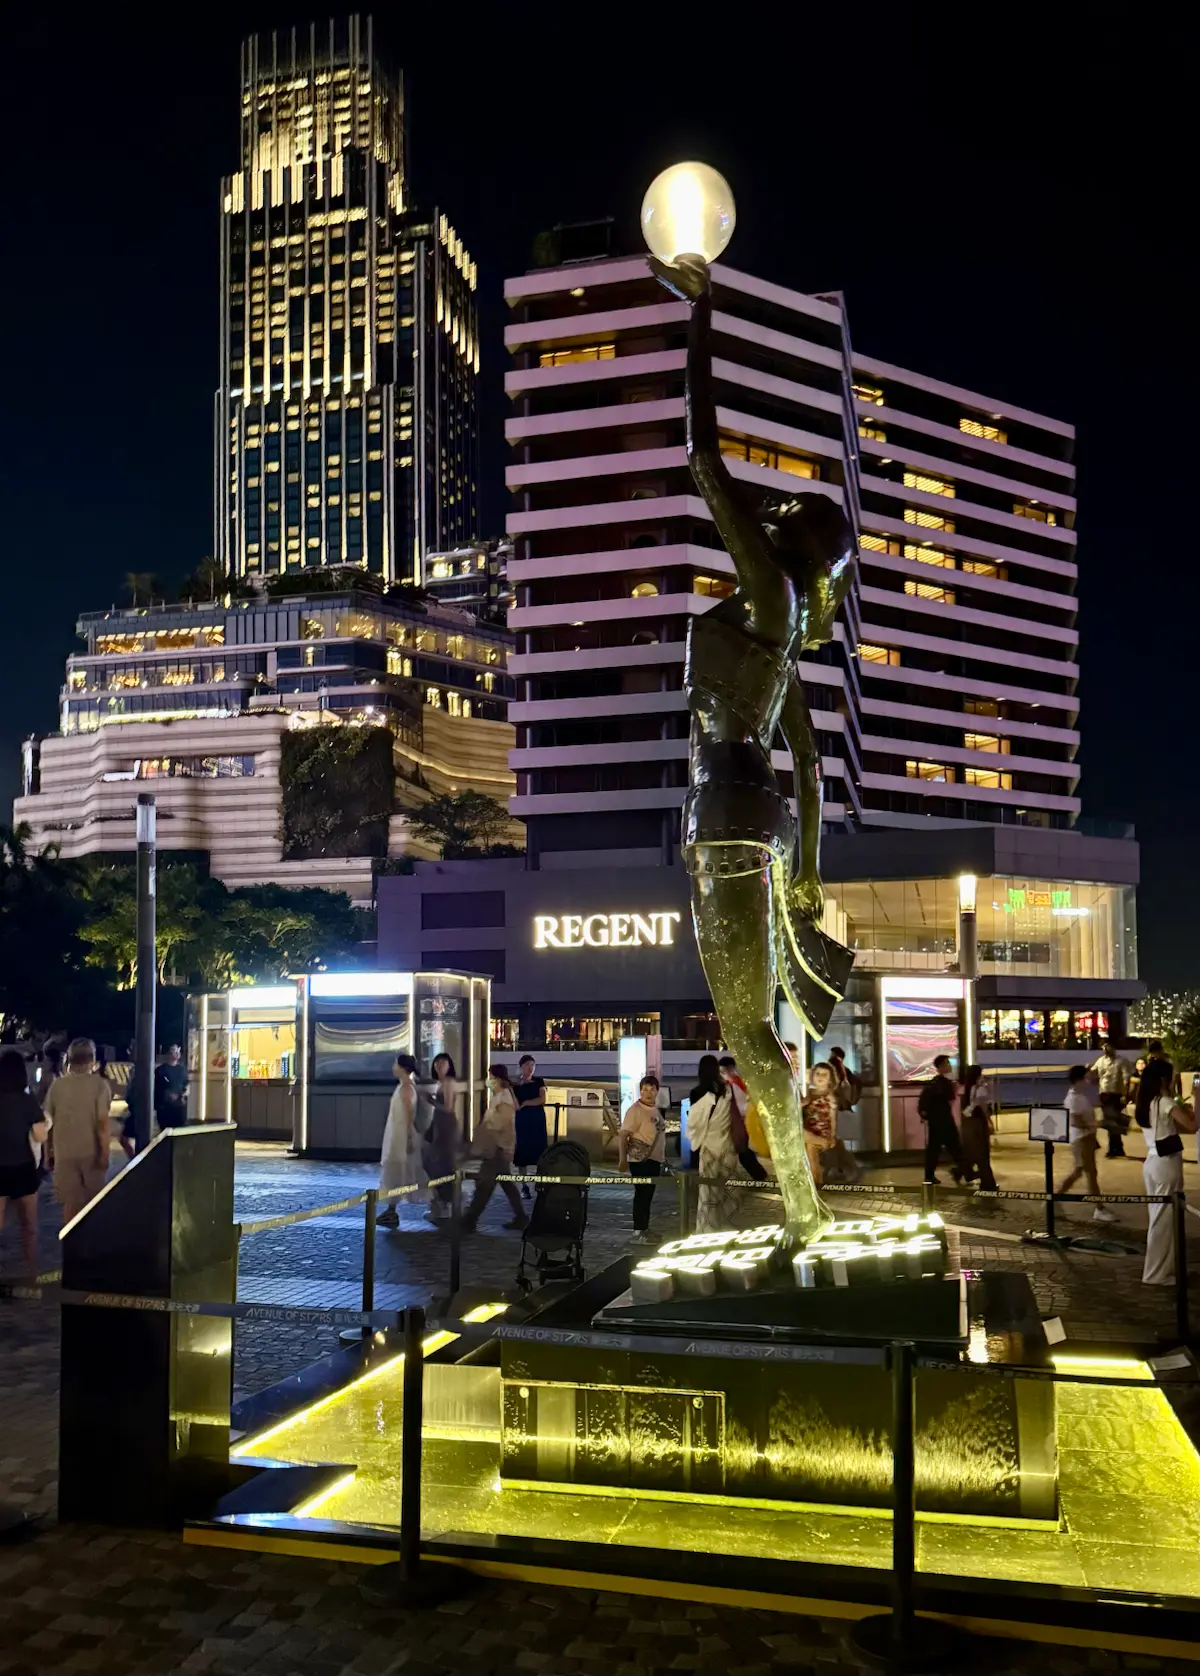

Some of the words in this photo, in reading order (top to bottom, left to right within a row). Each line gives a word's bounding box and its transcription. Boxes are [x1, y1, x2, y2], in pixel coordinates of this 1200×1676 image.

[534, 912, 680, 949] REGENT
[845, 1184, 852, 1192] OF
[973, 1190, 998, 1198] AVENUE
[84, 1293, 121, 1306] AVENUE
[122, 1296, 134, 1306] OF
[245, 1307, 285, 1320] AVENUE
[285, 1310, 297, 1321] OF
[492, 1328, 535, 1340] AVENUE
[535, 1330, 552, 1341] OF
[684, 1341, 732, 1356] AVENUE
[732, 1344, 749, 1356] OF
